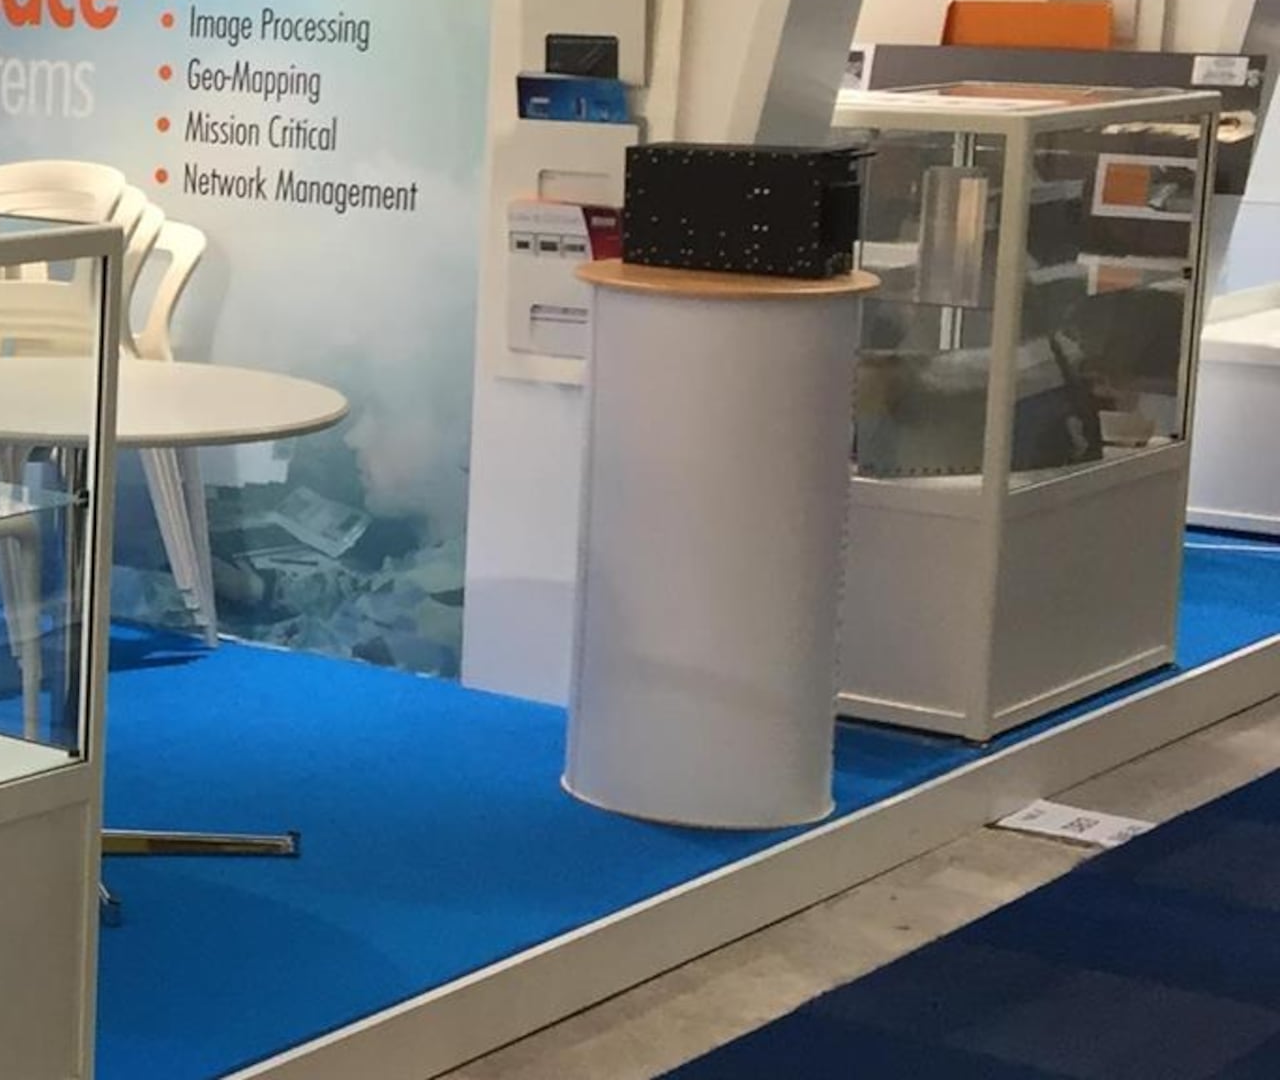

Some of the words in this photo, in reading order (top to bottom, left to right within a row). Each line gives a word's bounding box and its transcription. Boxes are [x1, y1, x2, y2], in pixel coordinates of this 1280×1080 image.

[190, 6, 252, 47] Image
[260, 7, 371, 52] Processing
[187, 58, 321, 104] Geo-Mapping
[185, 111, 260, 147] Mission
[268, 114, 338, 151] Critical
[184, 162, 268, 201] Network
[275, 170, 419, 214] Management
